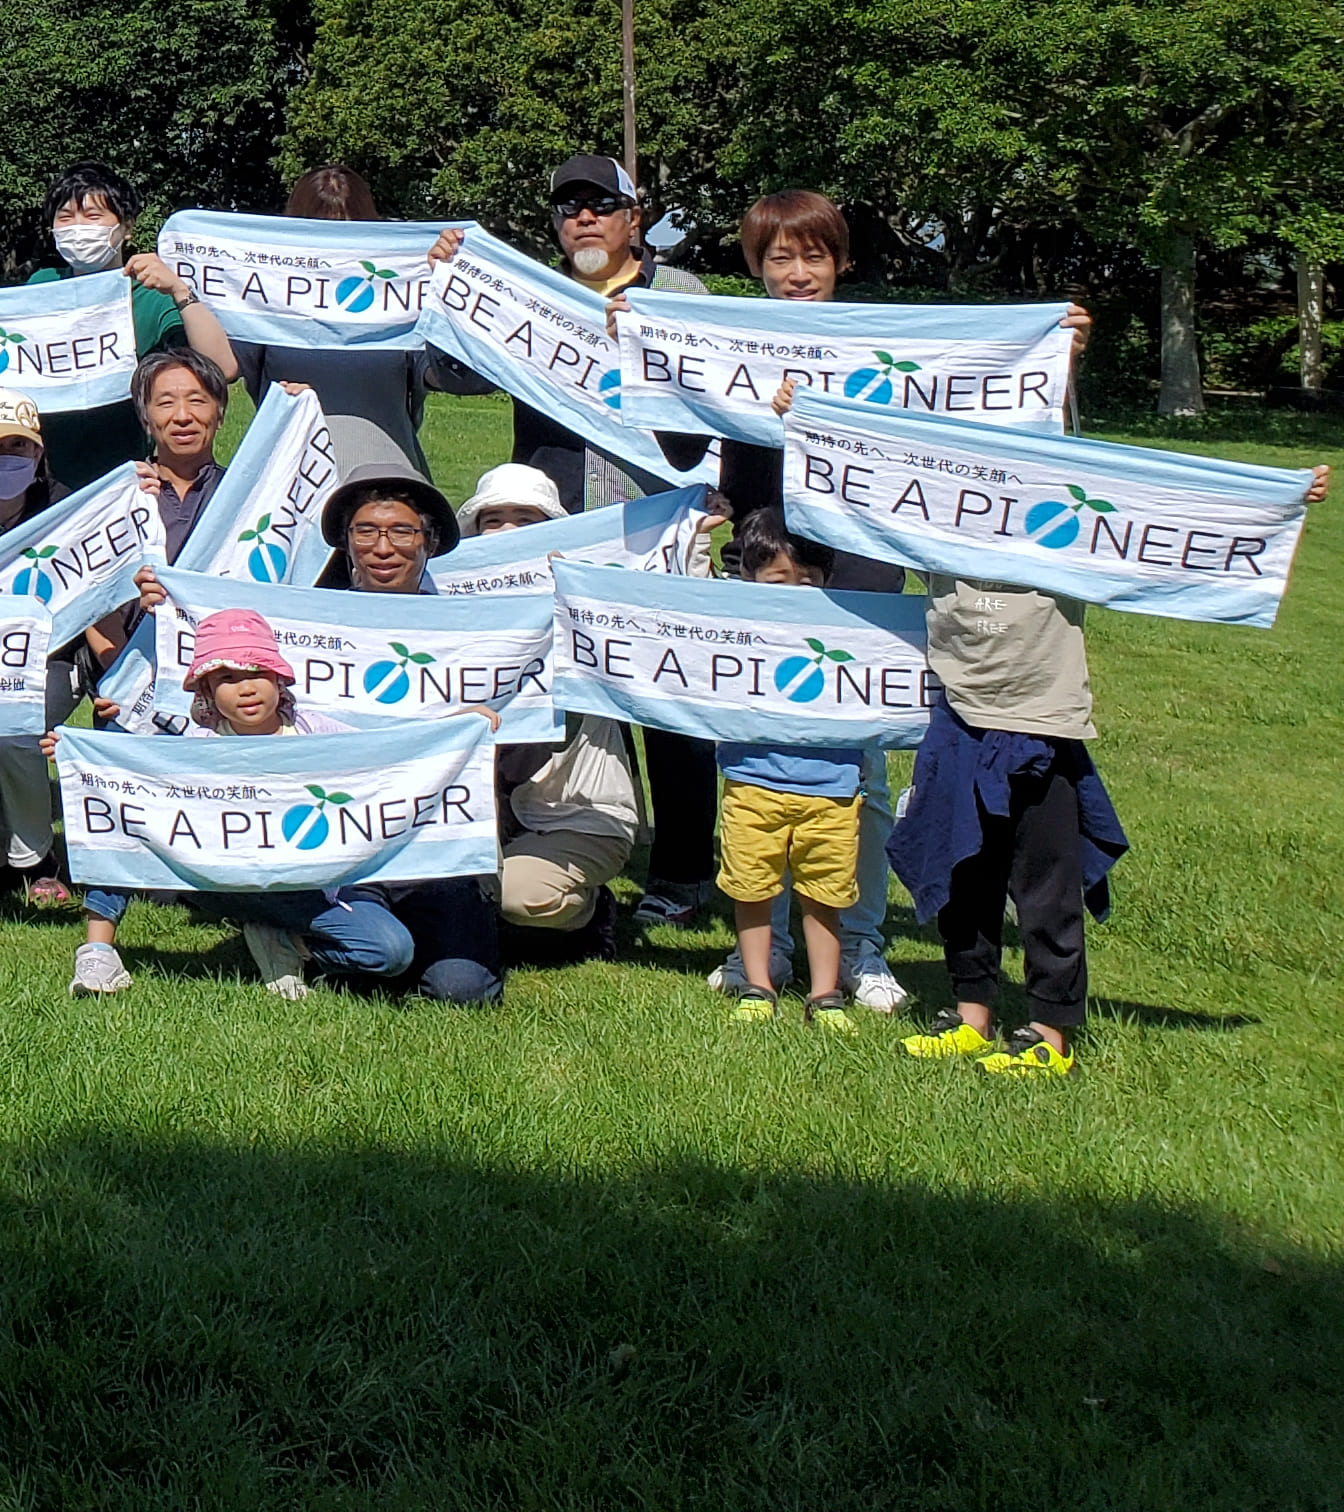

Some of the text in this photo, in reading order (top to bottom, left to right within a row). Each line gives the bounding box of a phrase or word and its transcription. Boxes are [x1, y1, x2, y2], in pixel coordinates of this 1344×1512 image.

[177, 262, 226, 297] BE
[241, 272, 269, 304] A
[441, 274, 501, 332] BE
[505, 319, 532, 358] A
[640, 324, 838, 360] 期待の先へ、次世代の笑顔へ
[642, 348, 706, 393] BE
[725, 363, 760, 401] A
[805, 432, 1024, 486] 期待の先へ、次世代の笑顔へ
[804, 453, 1267, 576] BE A PIONEER
[569, 607, 768, 647] 期待の先へ、次世代の笑顔へ
[975, 596, 1008, 612] ARE
[977, 620, 1009, 636] FREE
[306, 658, 548, 704] PIONEER
[572, 629, 634, 679] BE
[653, 648, 689, 688] A
[81, 772, 272, 801] 期待の先へ、次世代の笑顔へ
[84, 784, 474, 850] BE A PIONEER
